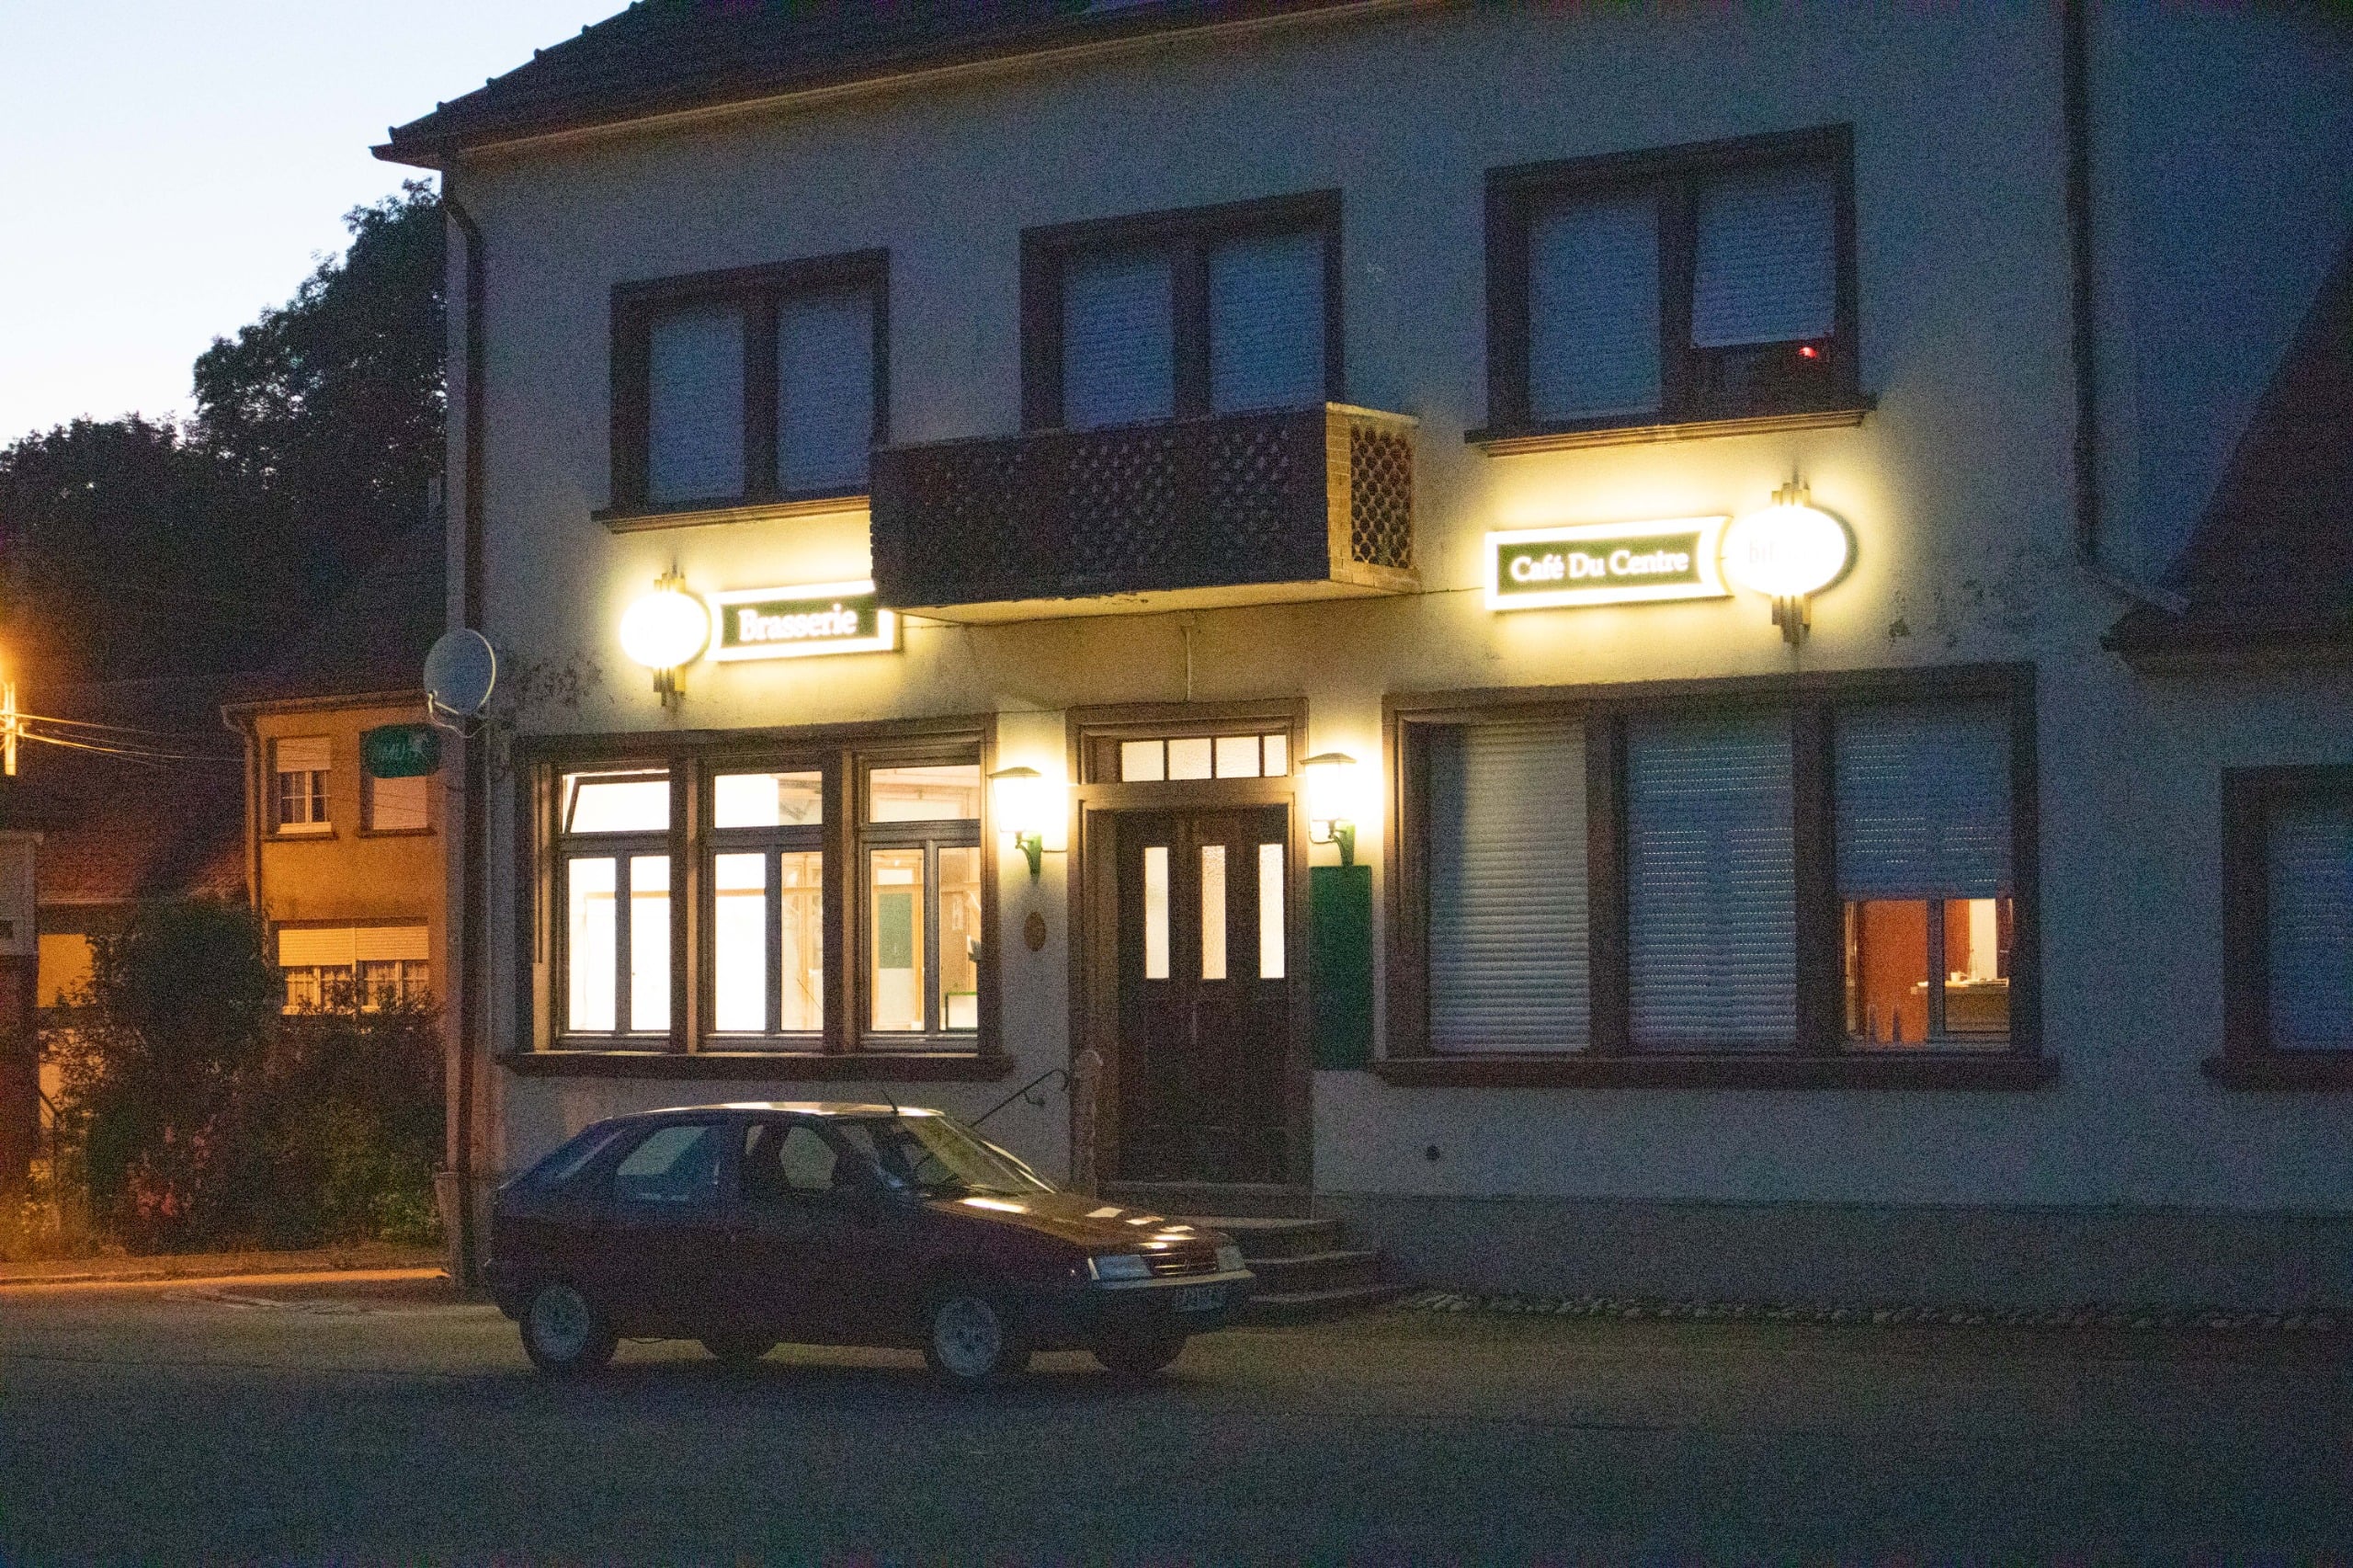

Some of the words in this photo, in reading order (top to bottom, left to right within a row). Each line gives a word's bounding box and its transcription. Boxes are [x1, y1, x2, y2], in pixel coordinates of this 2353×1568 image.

[1510, 554, 1564, 581] Café
[1569, 553, 1606, 578] Du
[1609, 550, 1689, 574] Centre
[738, 603, 858, 642] Brasserie
